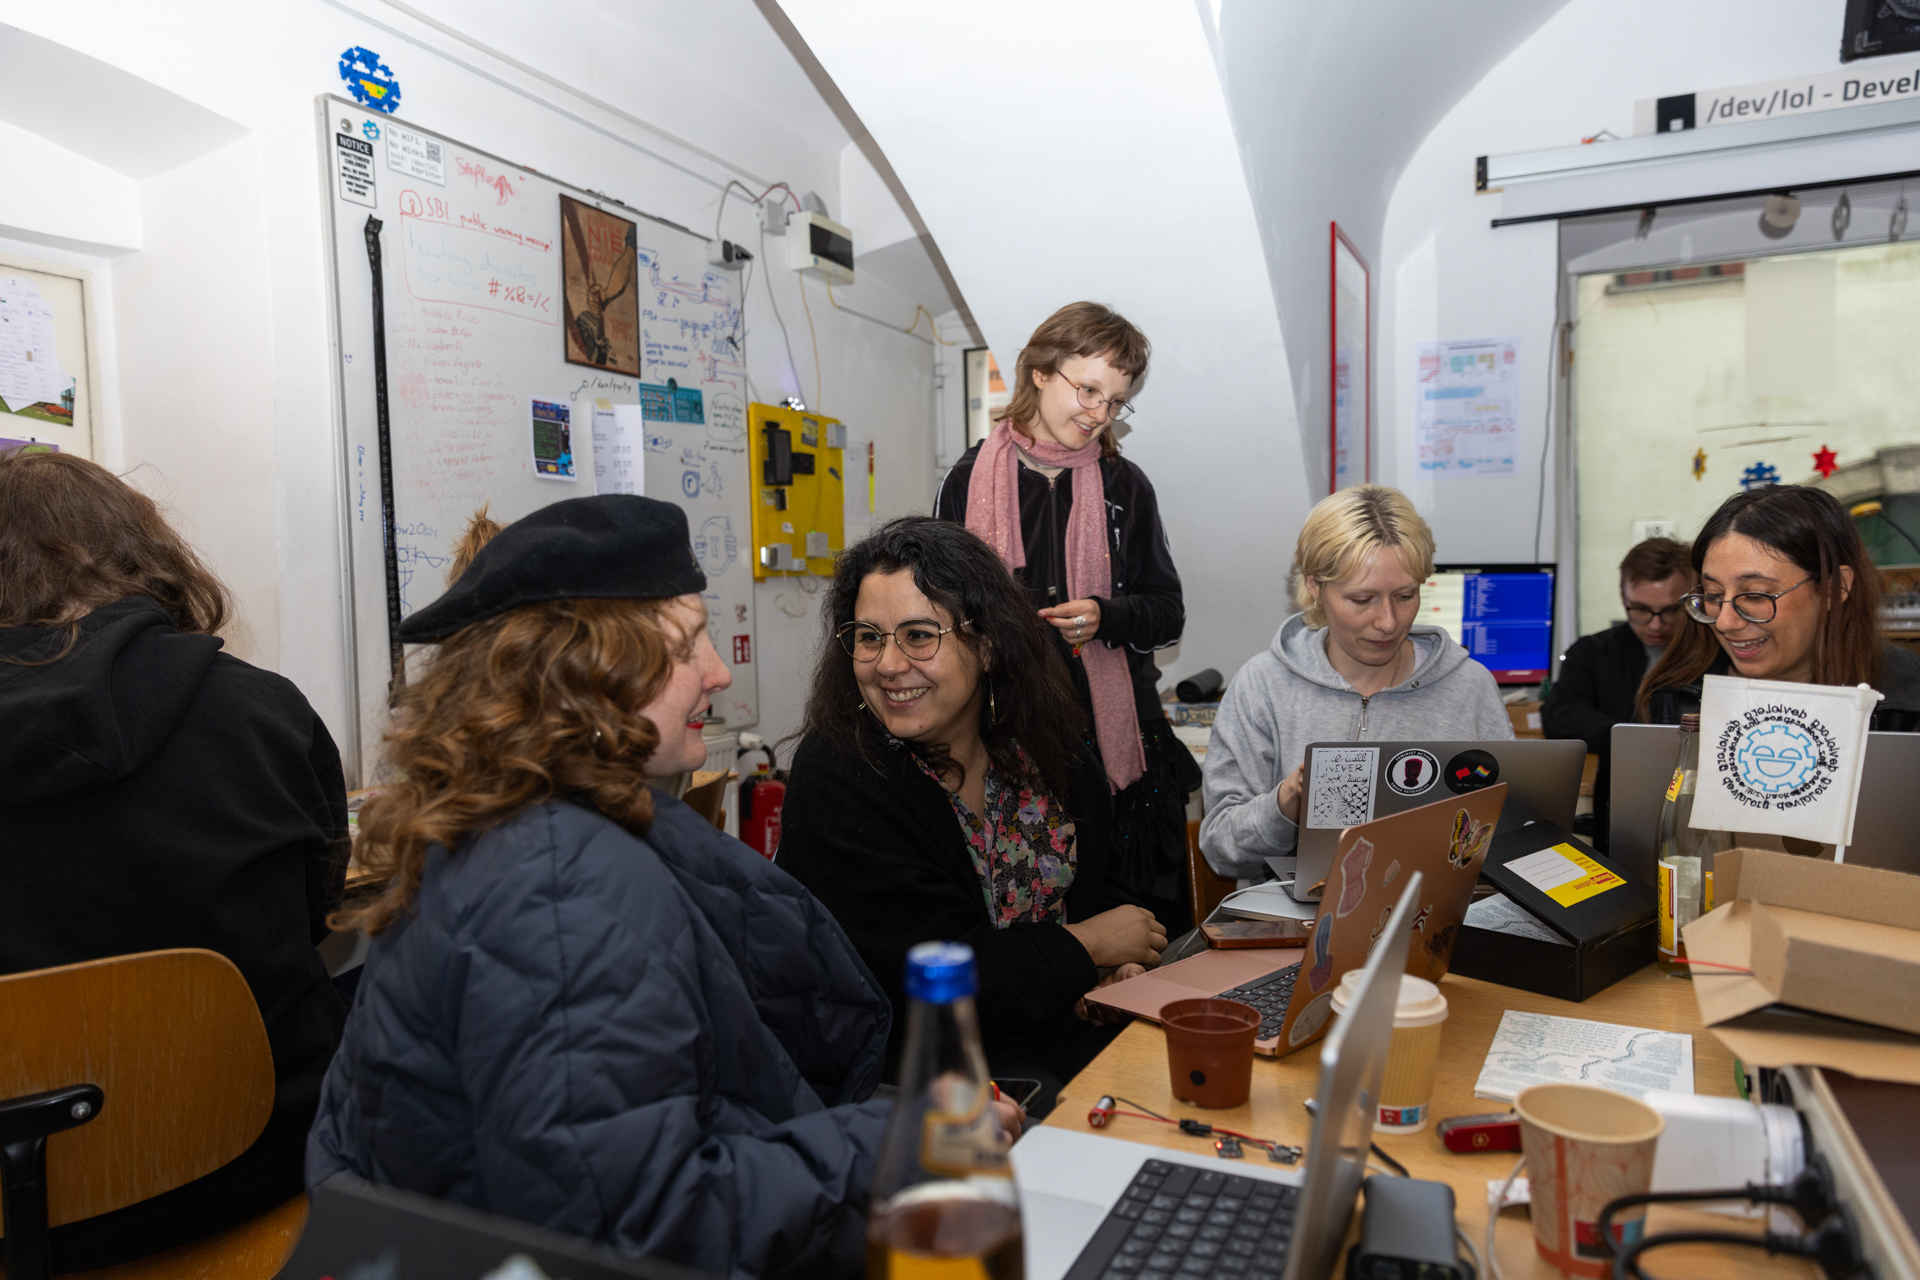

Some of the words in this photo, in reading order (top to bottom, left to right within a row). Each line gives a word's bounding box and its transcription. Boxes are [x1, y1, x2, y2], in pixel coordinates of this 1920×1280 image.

[1706, 85, 1815, 124] /dev/lol
[1842, 69, 1920, 102] Devel
[339, 135, 371, 154] NOTICE
[588, 225, 623, 254] NIE
